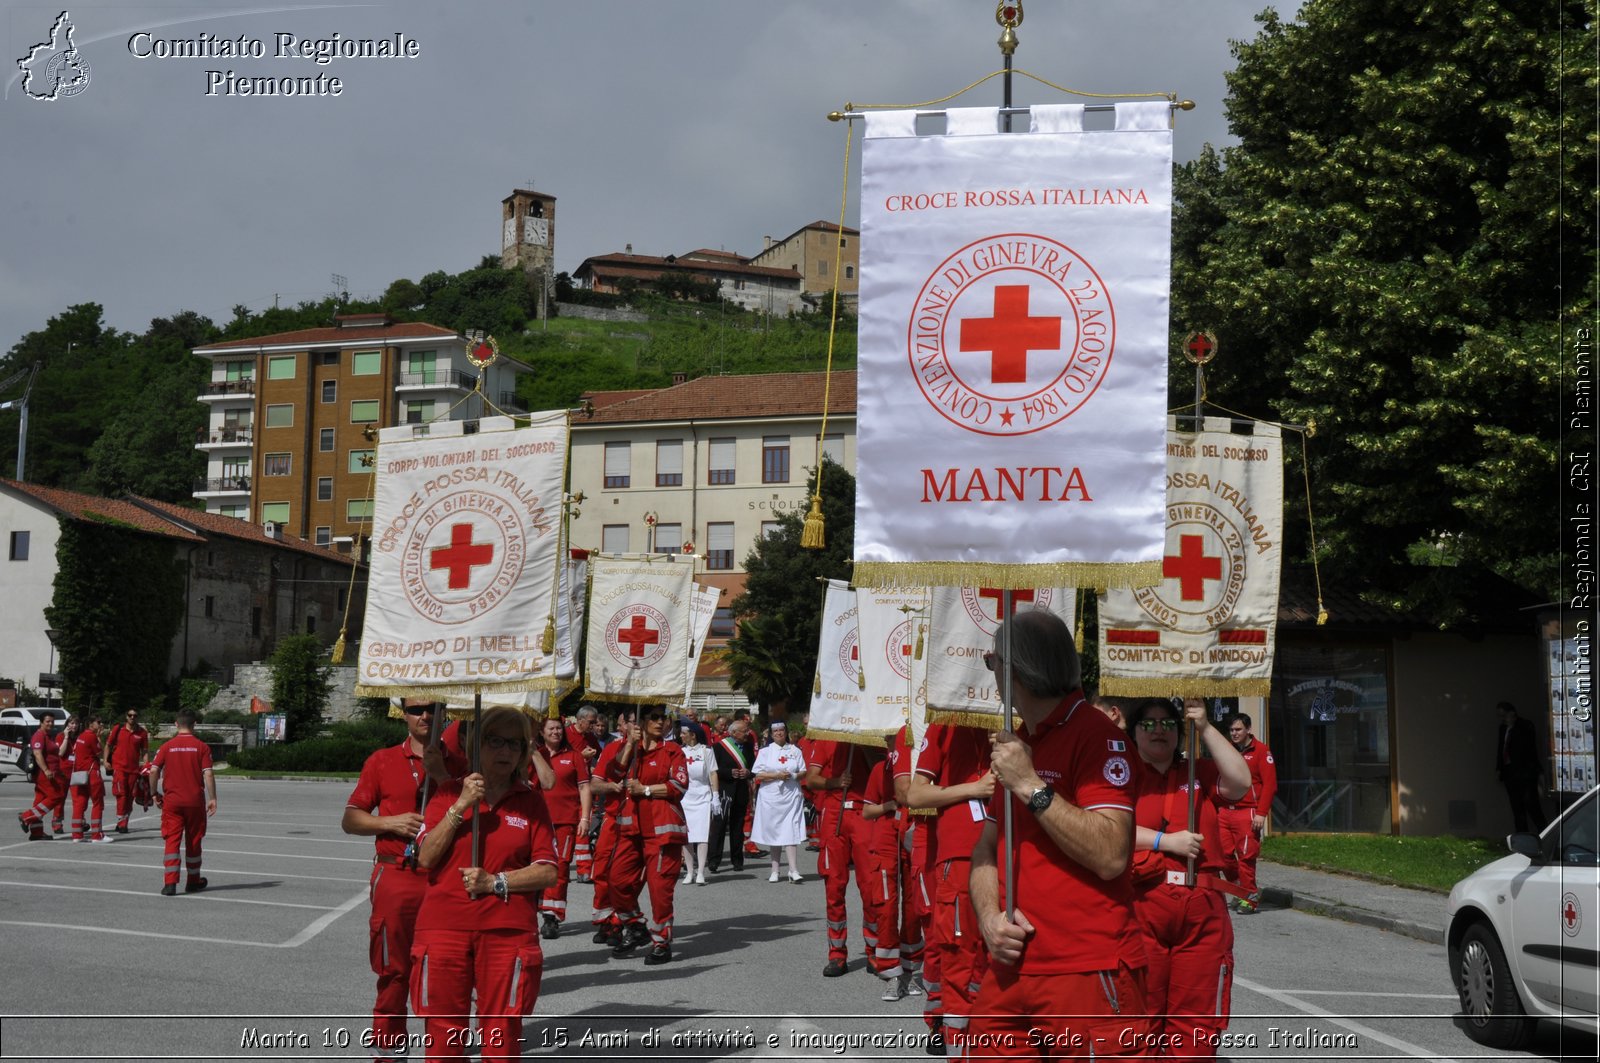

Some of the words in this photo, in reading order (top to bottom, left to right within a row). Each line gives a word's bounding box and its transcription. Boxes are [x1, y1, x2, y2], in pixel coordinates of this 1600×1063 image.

[885, 192, 958, 212] CROCE
[964, 190, 1036, 207] ROSSA
[1041, 188, 1150, 206] ITALIANA
[942, 259, 974, 290] DI
[972, 241, 1073, 282] GINEVRA
[1069, 279, 1099, 305] 22
[916, 284, 993, 425] CONVENZIONE
[1064, 308, 1107, 394] AGOSTO
[1022, 388, 1069, 425] 1864
[388, 458, 418, 474] CORPO
[422, 451, 475, 468] VOLONTARI
[481, 448, 500, 462] DEL
[506, 441, 556, 459] SOCCORSO
[1202, 445, 1220, 458] DEL
[1223, 447, 1268, 461] SOCCORSO
[920, 467, 1093, 502] MANTA
[378, 491, 425, 553] CROCE
[424, 466, 489, 496] ROSSA
[493, 470, 551, 538] ITALIANA
[424, 509, 438, 526] DI
[443, 494, 505, 517] GINEVRA
[1214, 479, 1273, 555] ITALIANA
[502, 514, 517, 532] 22
[1168, 507, 1226, 533] GINEVRA
[1225, 533, 1241, 551] 22
[498, 534, 521, 587] AGOSTO
[405, 531, 443, 619] CONVENZIONE
[1226, 555, 1244, 605] AGOSTO
[1138, 588, 1178, 626] CONVE
[367, 638, 447, 659] GRUPPO
[453, 636, 471, 653] DI
[946, 646, 991, 658] COMITA
[1107, 648, 1184, 664] COMITATO
[1189, 650, 1204, 664] DI
[366, 659, 454, 678] COMITATO
[465, 656, 543, 676] LOCALE
[826, 692, 858, 703] COMITA
